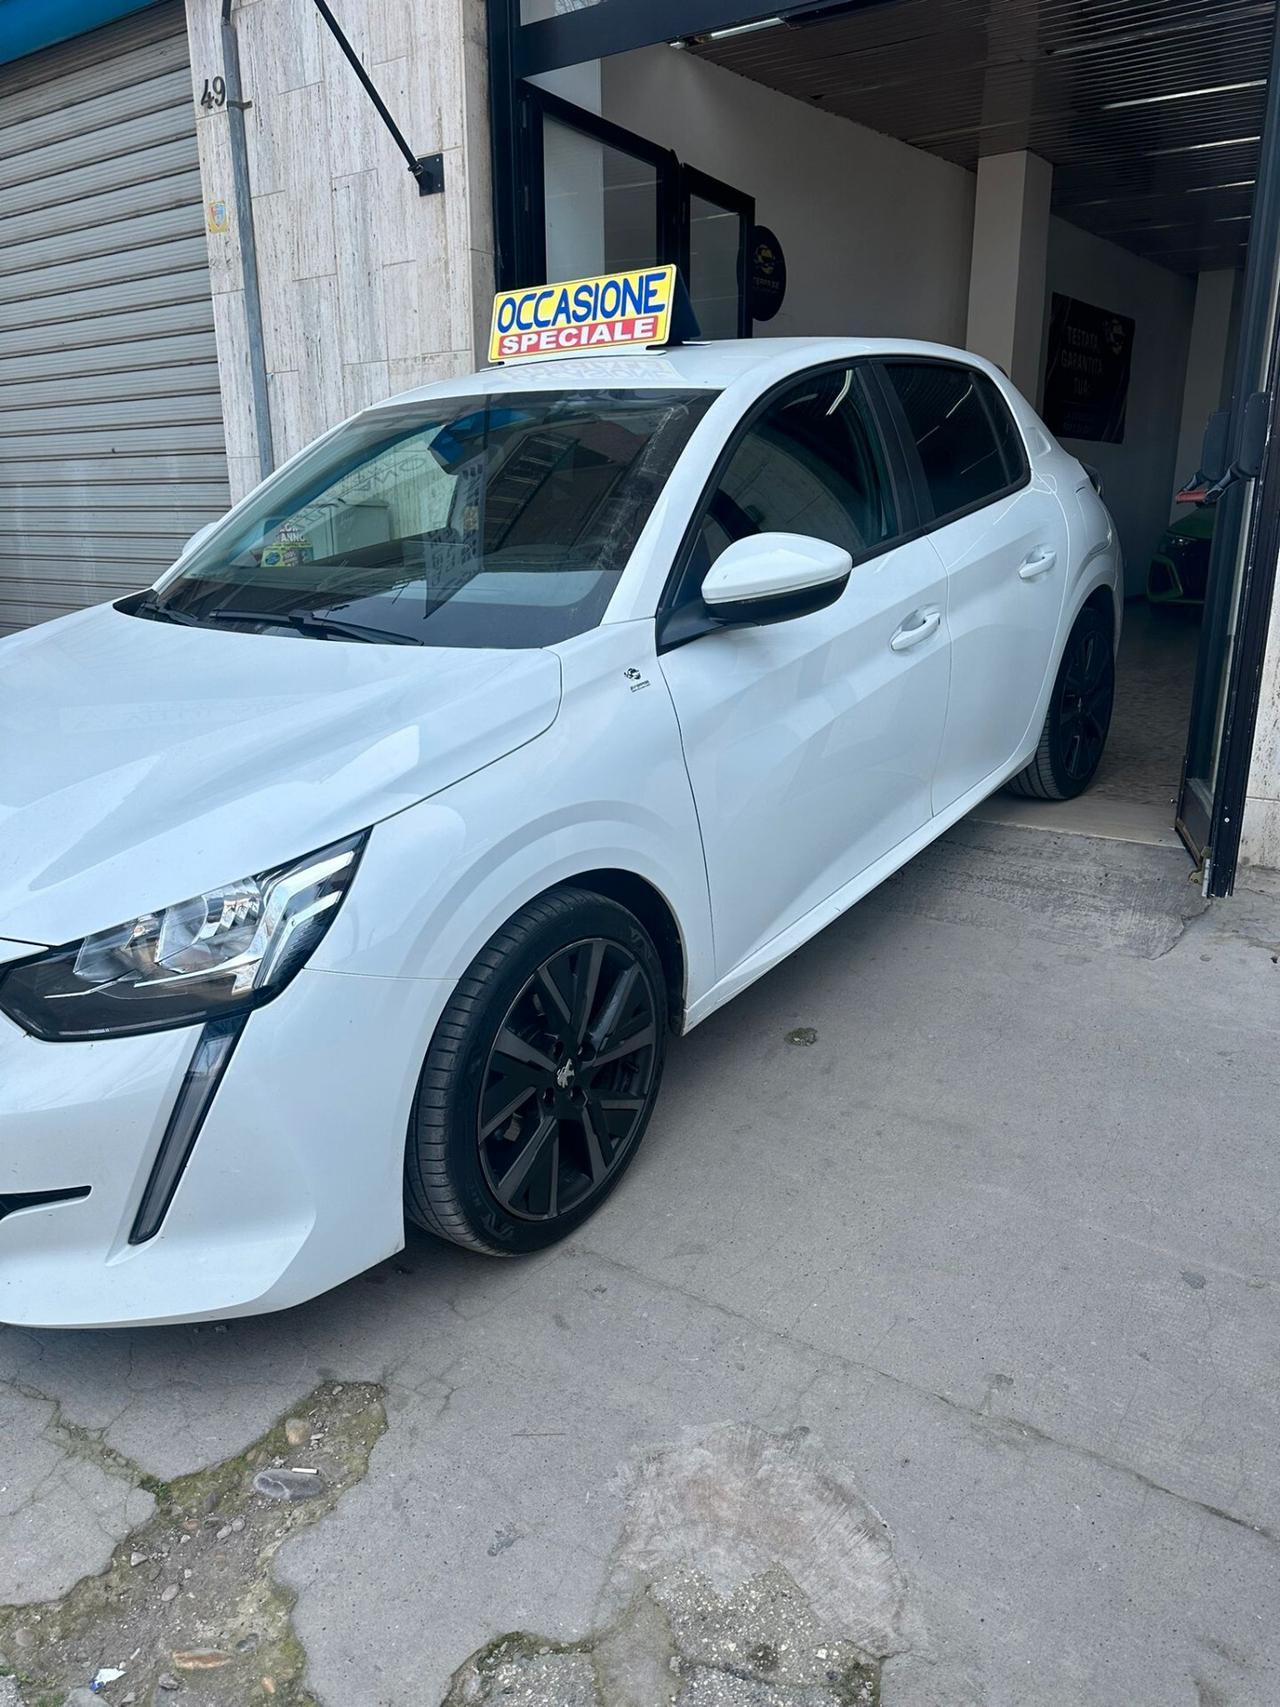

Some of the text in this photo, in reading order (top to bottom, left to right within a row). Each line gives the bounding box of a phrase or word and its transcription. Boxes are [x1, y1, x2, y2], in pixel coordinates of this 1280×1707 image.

[200, 75, 226, 110] 49
[497, 271, 667, 334] OCCASIONE
[501, 317, 656, 355] SPECIALE
